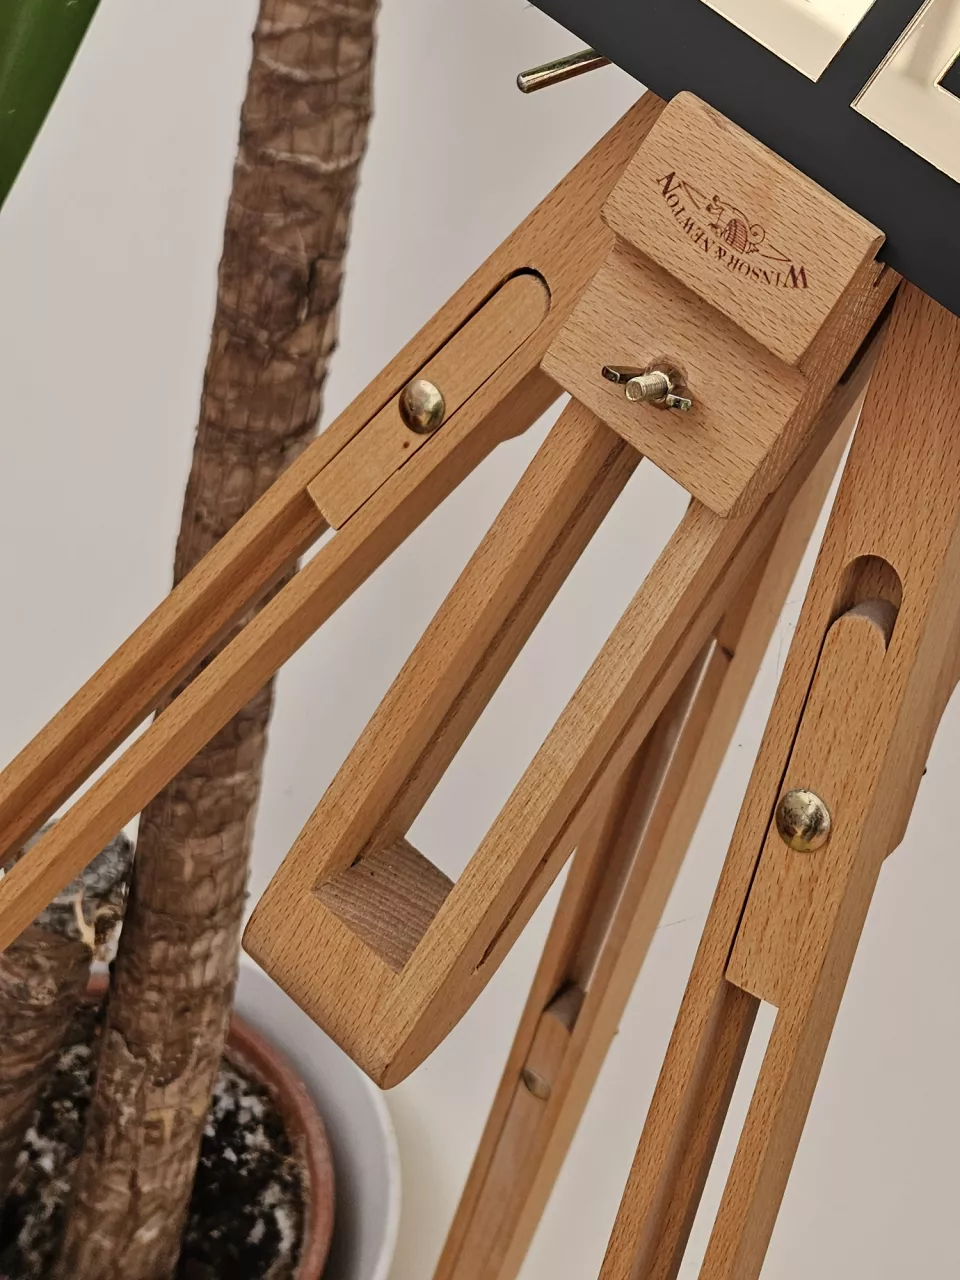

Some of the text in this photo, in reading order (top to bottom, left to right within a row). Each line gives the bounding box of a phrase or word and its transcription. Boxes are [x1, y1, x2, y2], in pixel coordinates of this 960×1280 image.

[656, 171, 809, 289] WINSOR & NEWTON
